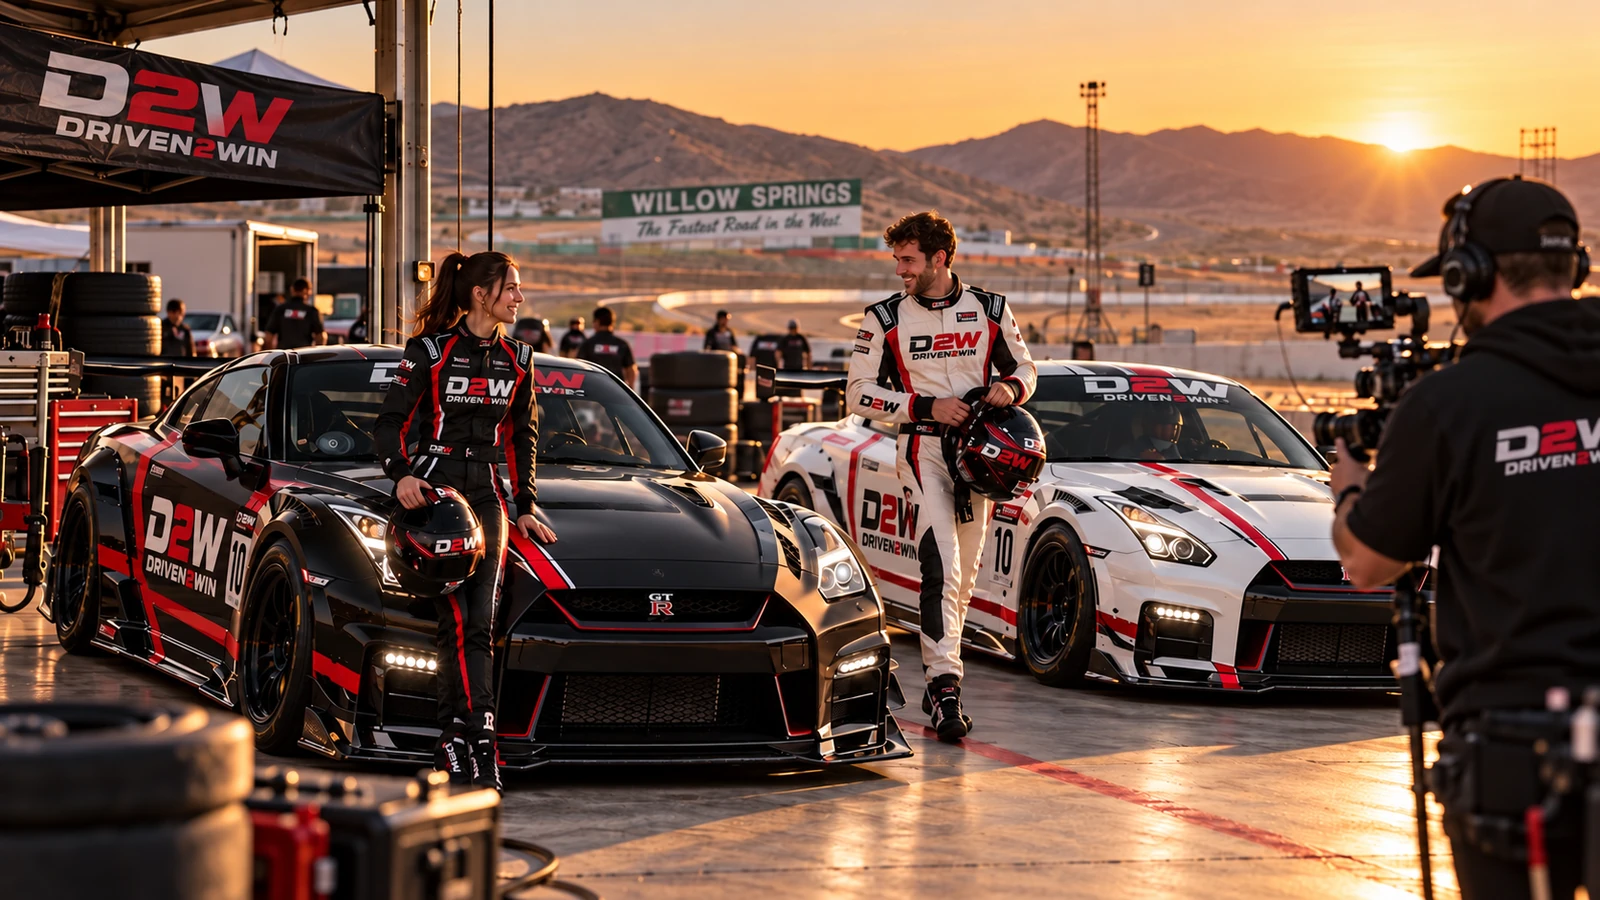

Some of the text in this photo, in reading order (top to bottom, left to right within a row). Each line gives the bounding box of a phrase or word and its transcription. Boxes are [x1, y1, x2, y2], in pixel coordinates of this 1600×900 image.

[38, 51, 294, 145] D2W
[55, 114, 278, 169] DRIVEN2WIN
[631, 182, 852, 214] WILLOW SPRINGS
[637, 220, 662, 237] The
[667, 218, 719, 236] Fastest
[723, 216, 760, 232] Road
[764, 215, 778, 230] in
[784, 213, 804, 230] the
[909, 331, 982, 353] D2W
[912, 349, 977, 360] DRIVEN2WIN
[445, 376, 515, 397] D2W
[1083, 376, 1229, 398] D2W
[1103, 393, 1220, 404] DRIVEN2WIN
[859, 394, 900, 413] D2W
[981, 442, 1032, 470] D2W
[860, 488, 920, 541] D2W
[144, 495, 228, 573] D2W
[434, 536, 477, 553] D2W
[862, 532, 918, 560] DRIVEN2WIN
[994, 526, 1014, 576] 10
[145, 554, 217, 598] DRIVEN2WIN
[231, 539, 245, 596] 10
